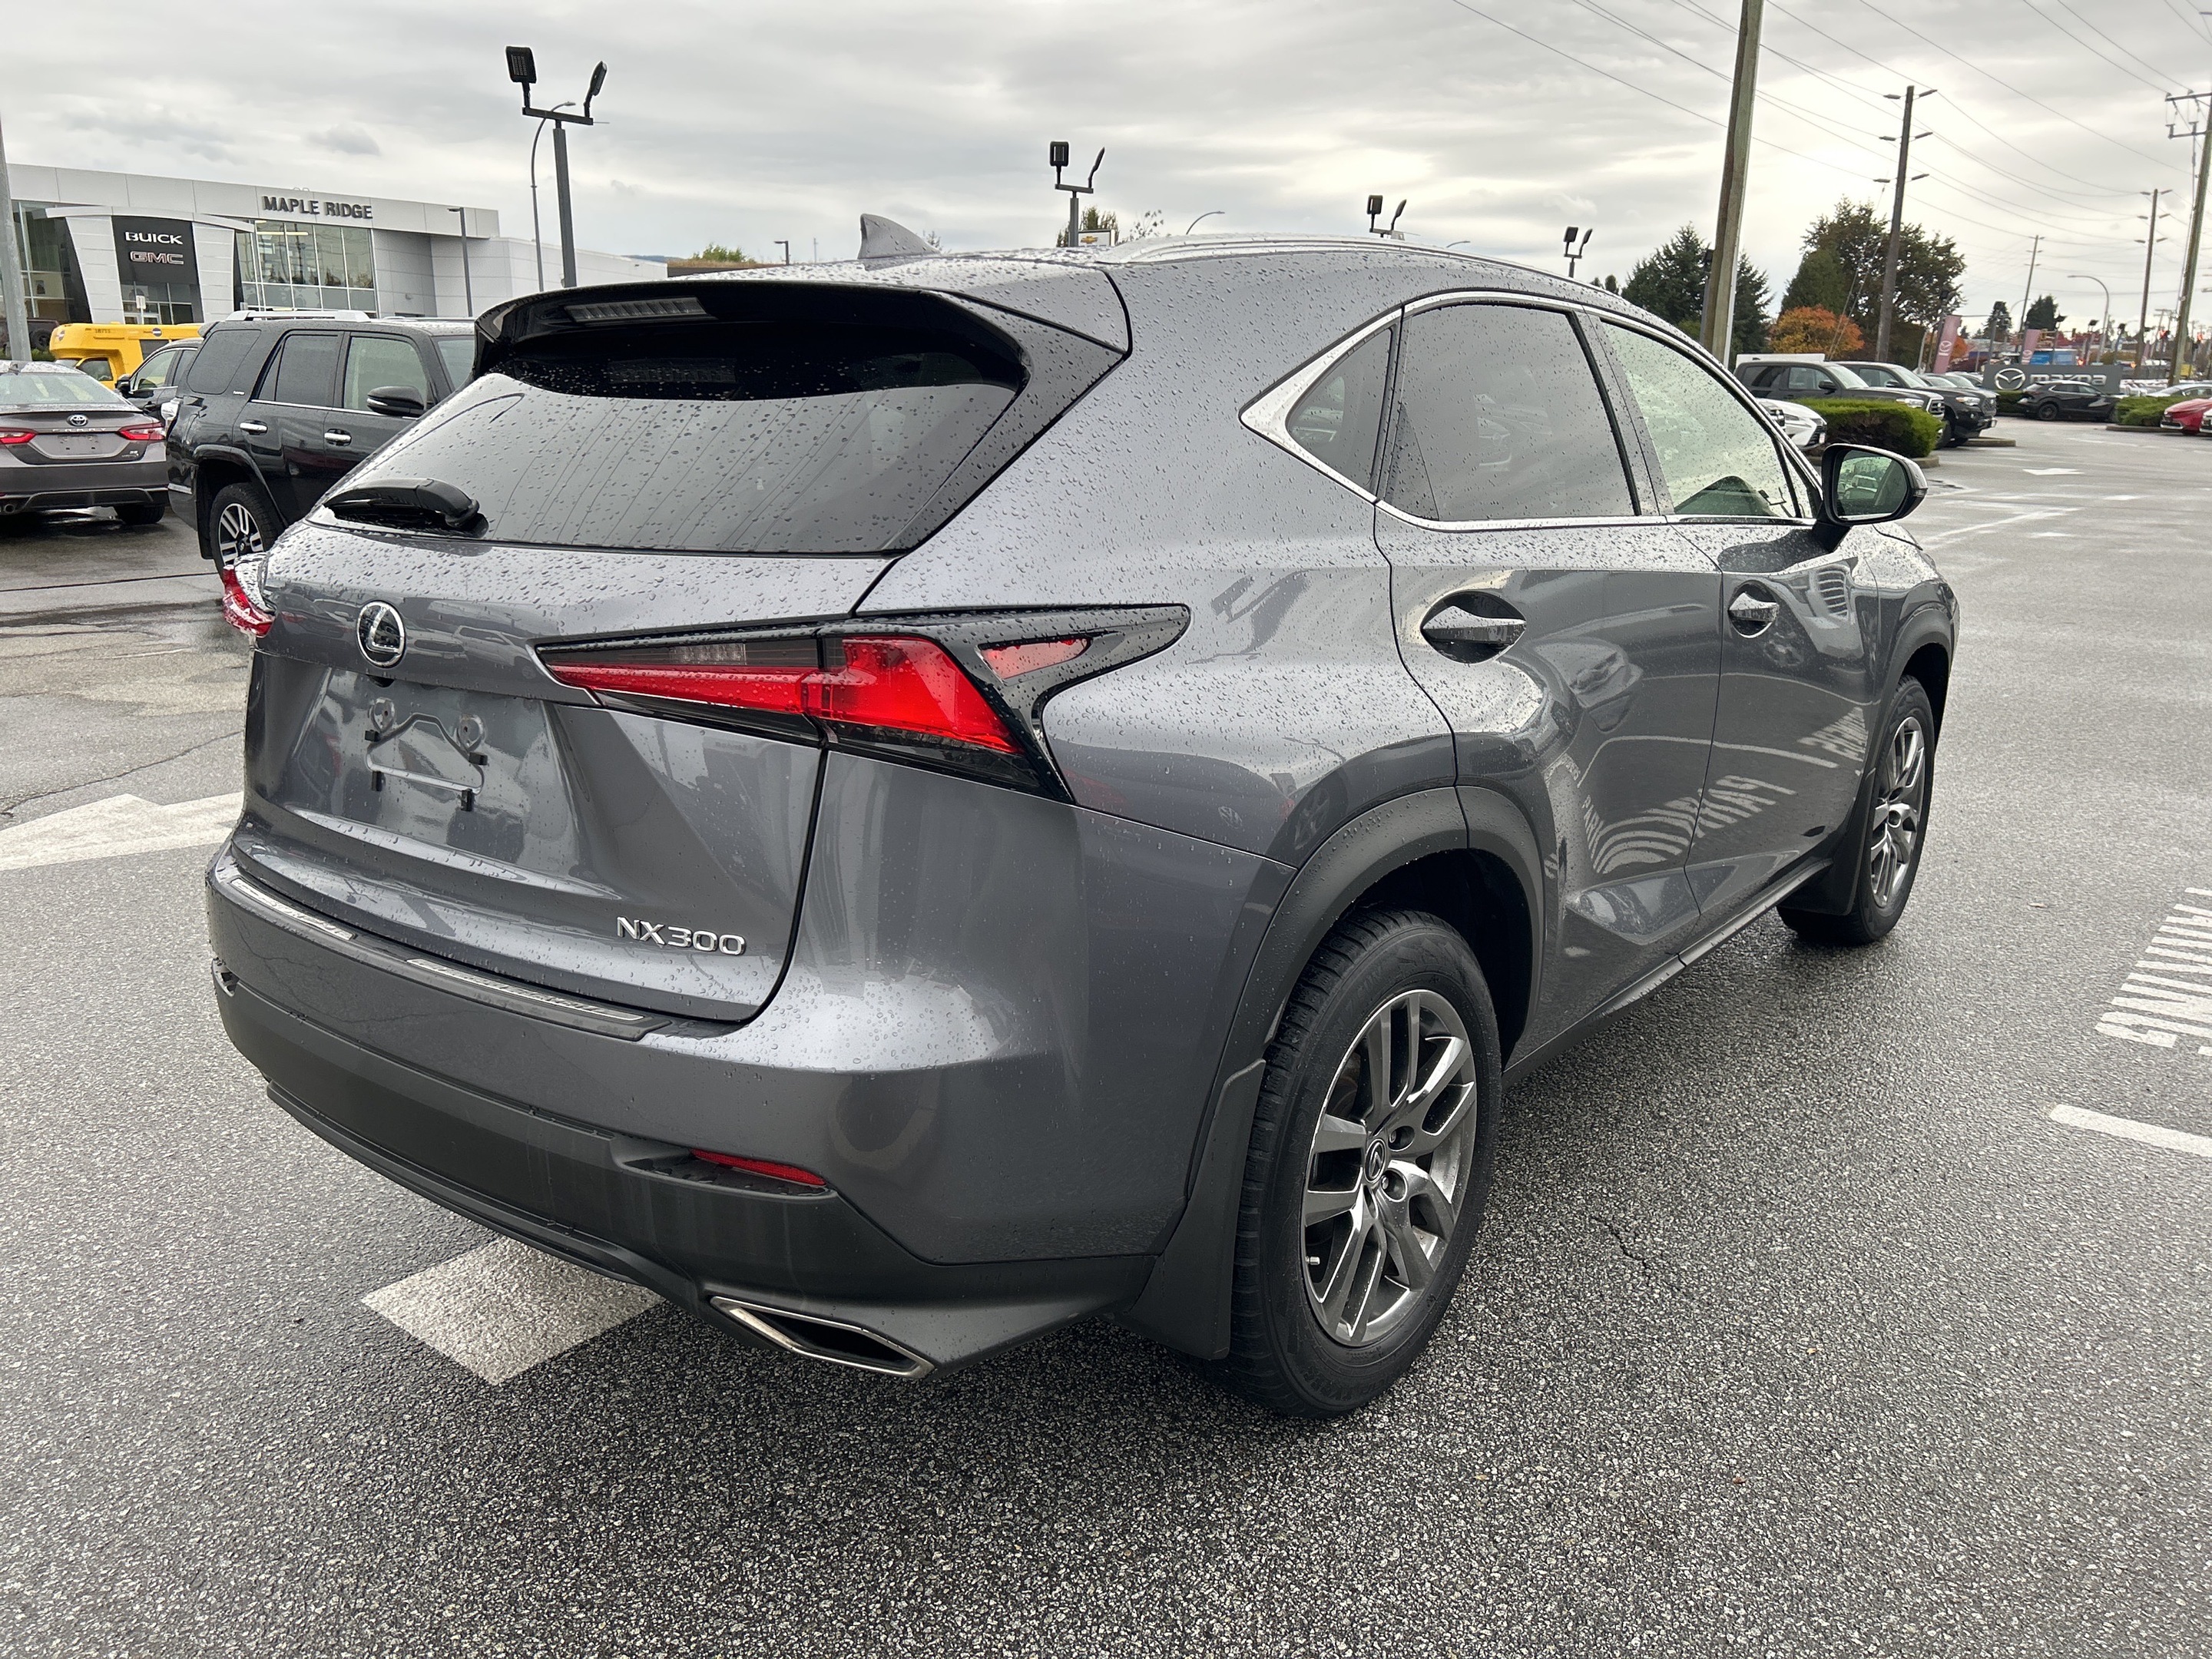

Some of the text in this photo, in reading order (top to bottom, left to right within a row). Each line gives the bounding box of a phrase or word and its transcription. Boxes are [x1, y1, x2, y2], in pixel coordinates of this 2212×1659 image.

[262, 196, 373, 219] MAPLE RIDGE
[124, 231, 183, 244] BUICK
[130, 250, 184, 265] GMC
[617, 916, 746, 955] NX300
